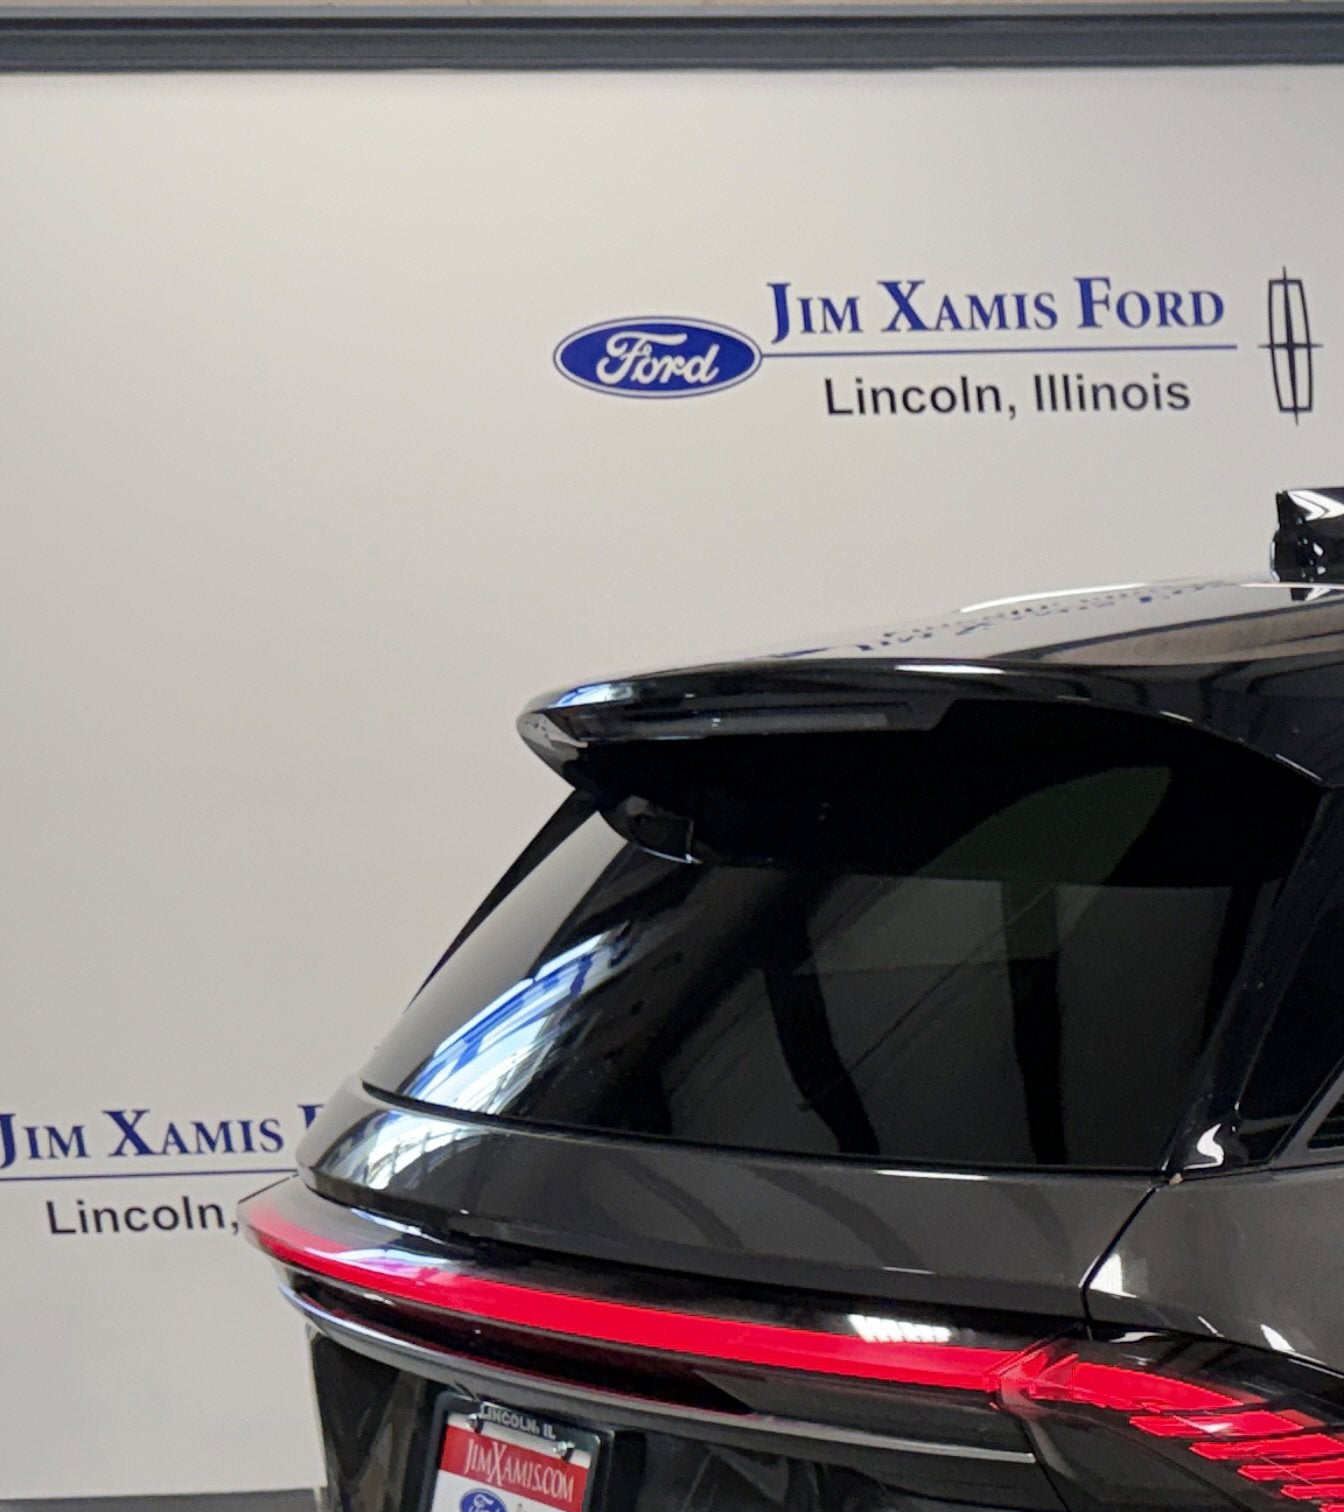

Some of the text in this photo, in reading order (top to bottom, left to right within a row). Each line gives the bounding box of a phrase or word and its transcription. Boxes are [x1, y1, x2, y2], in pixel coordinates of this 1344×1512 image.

[767, 277, 1225, 344] JIM XAMIS FORD
[595, 330, 720, 385] Ford
[824, 372, 1192, 421] Lincoln, Illinois
[102, 1108, 286, 1158] XAMIS
[46, 1196, 240, 1236] Lincoln,
[543, 1423, 557, 1440] IL
